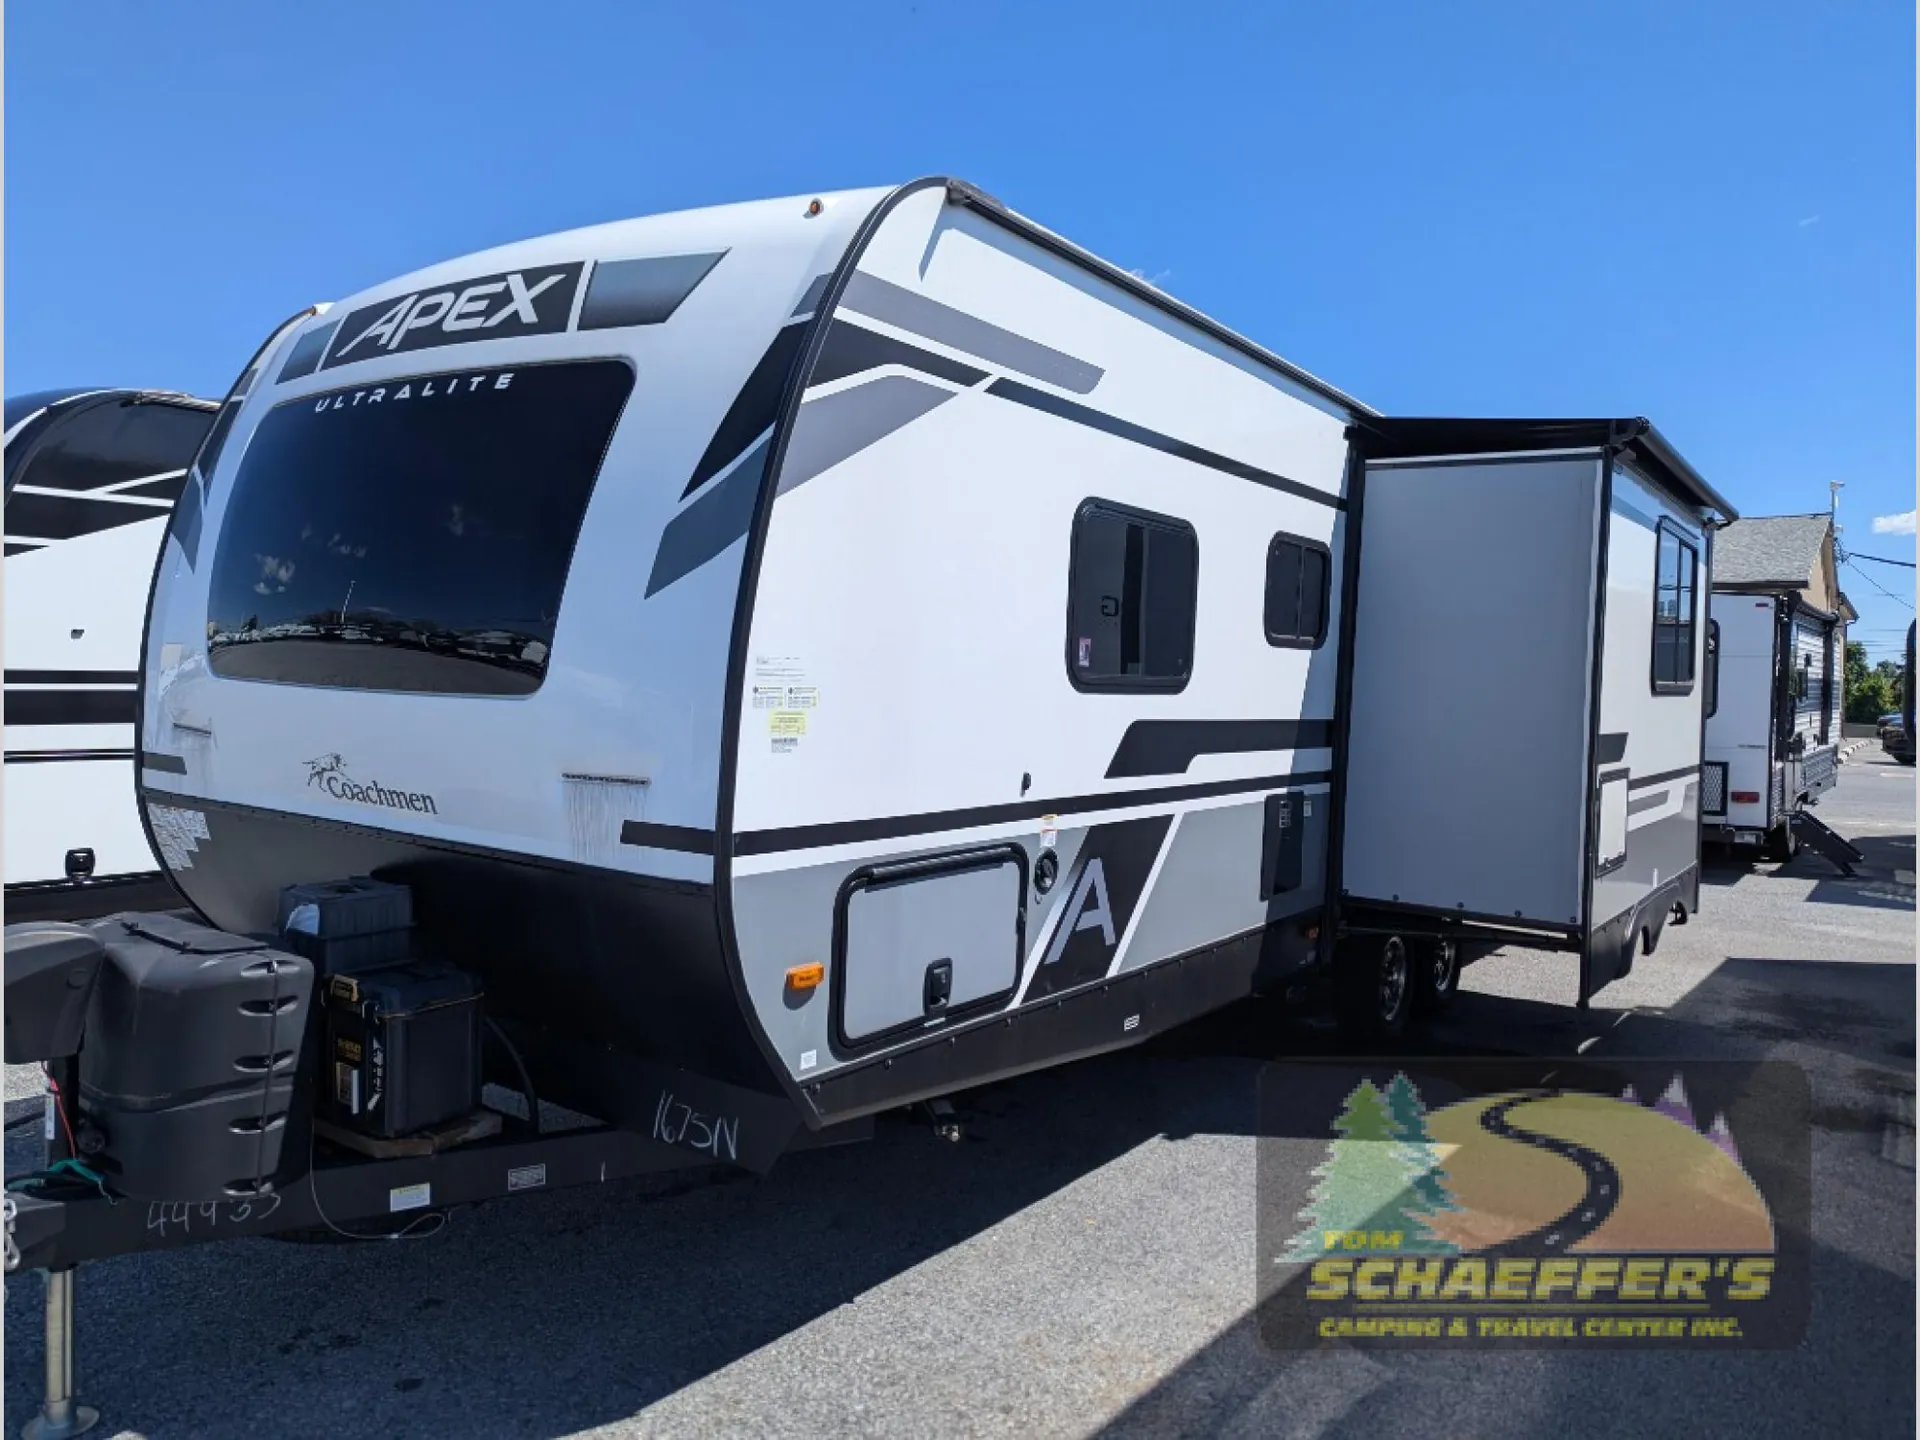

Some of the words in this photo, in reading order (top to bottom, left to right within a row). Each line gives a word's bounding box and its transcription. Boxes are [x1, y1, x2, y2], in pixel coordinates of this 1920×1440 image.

[336, 273, 566, 357] APEX
[315, 372, 515, 413] ULTRALITE
[326, 775, 438, 815] Coachmen
[1043, 856, 1117, 965] A
[653, 1090, 739, 1160] 1675N
